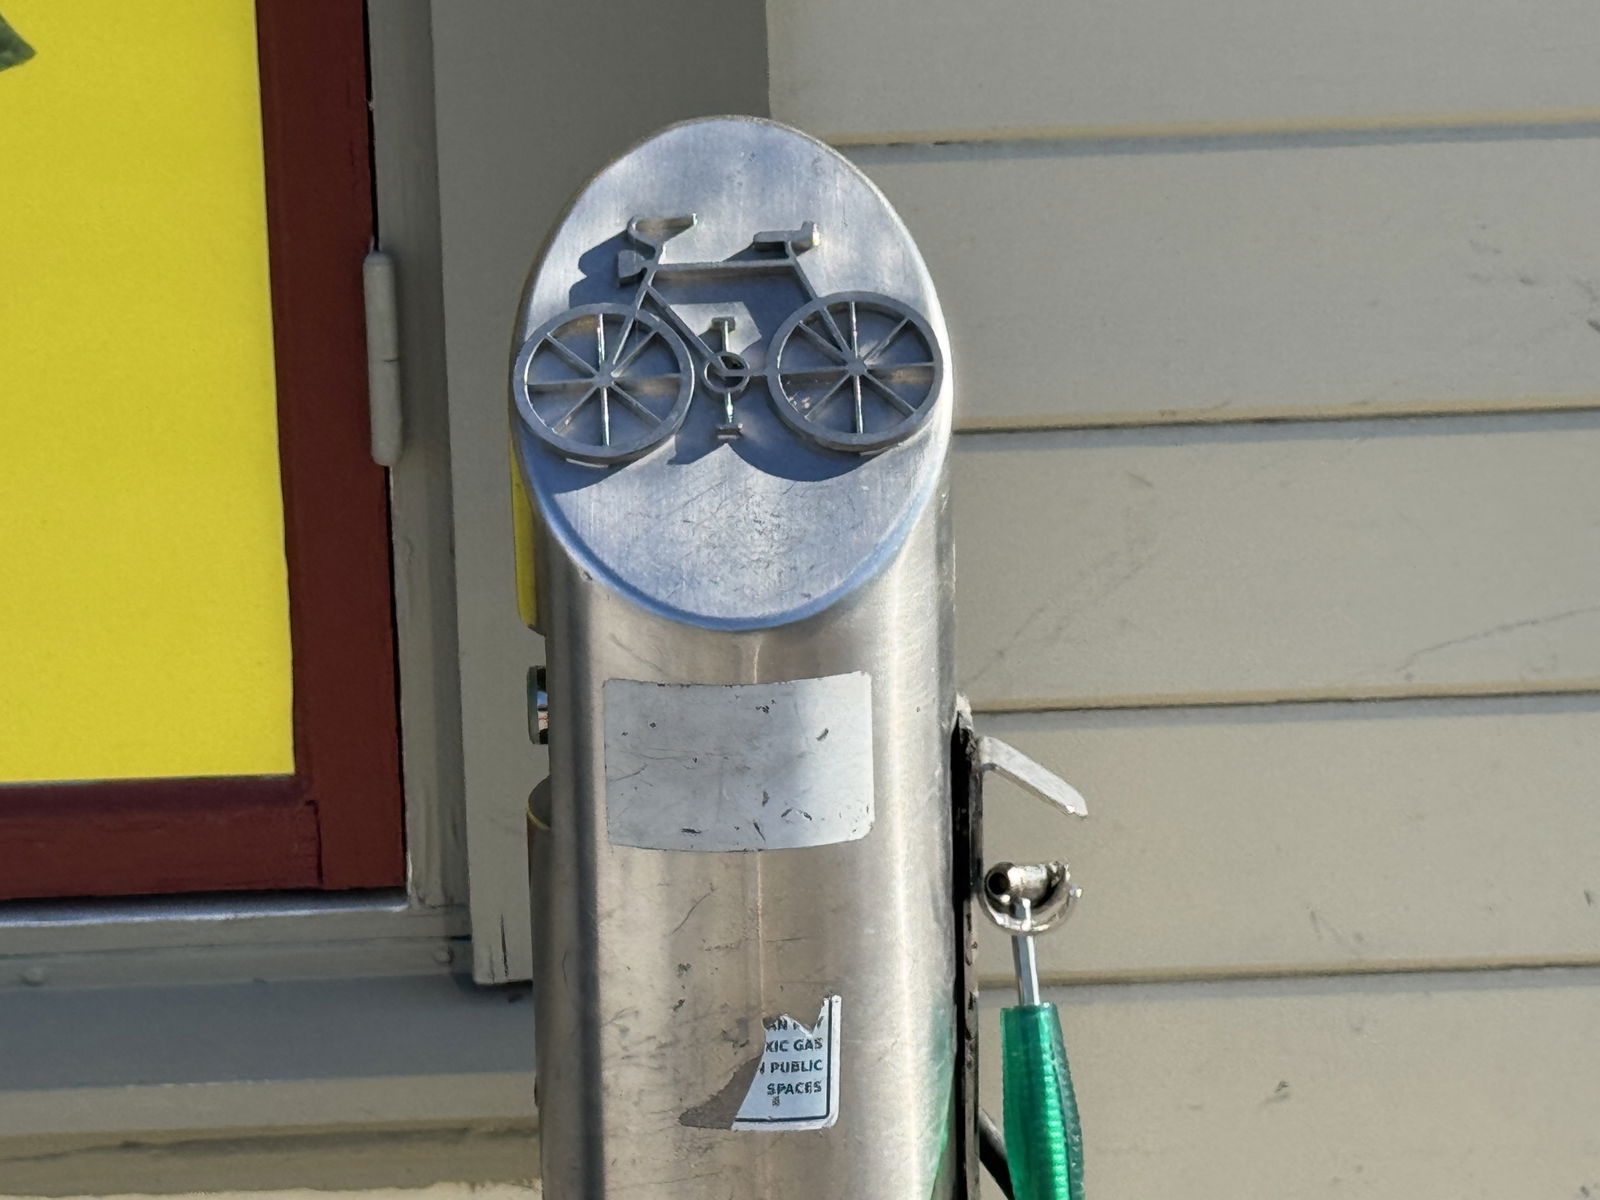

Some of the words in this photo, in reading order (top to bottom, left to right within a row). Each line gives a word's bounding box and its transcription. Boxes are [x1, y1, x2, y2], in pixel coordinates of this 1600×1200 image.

[793, 1038, 823, 1052] GAS
[770, 1059, 823, 1073] PUBLIC
[767, 1081, 822, 1095] SPACES
